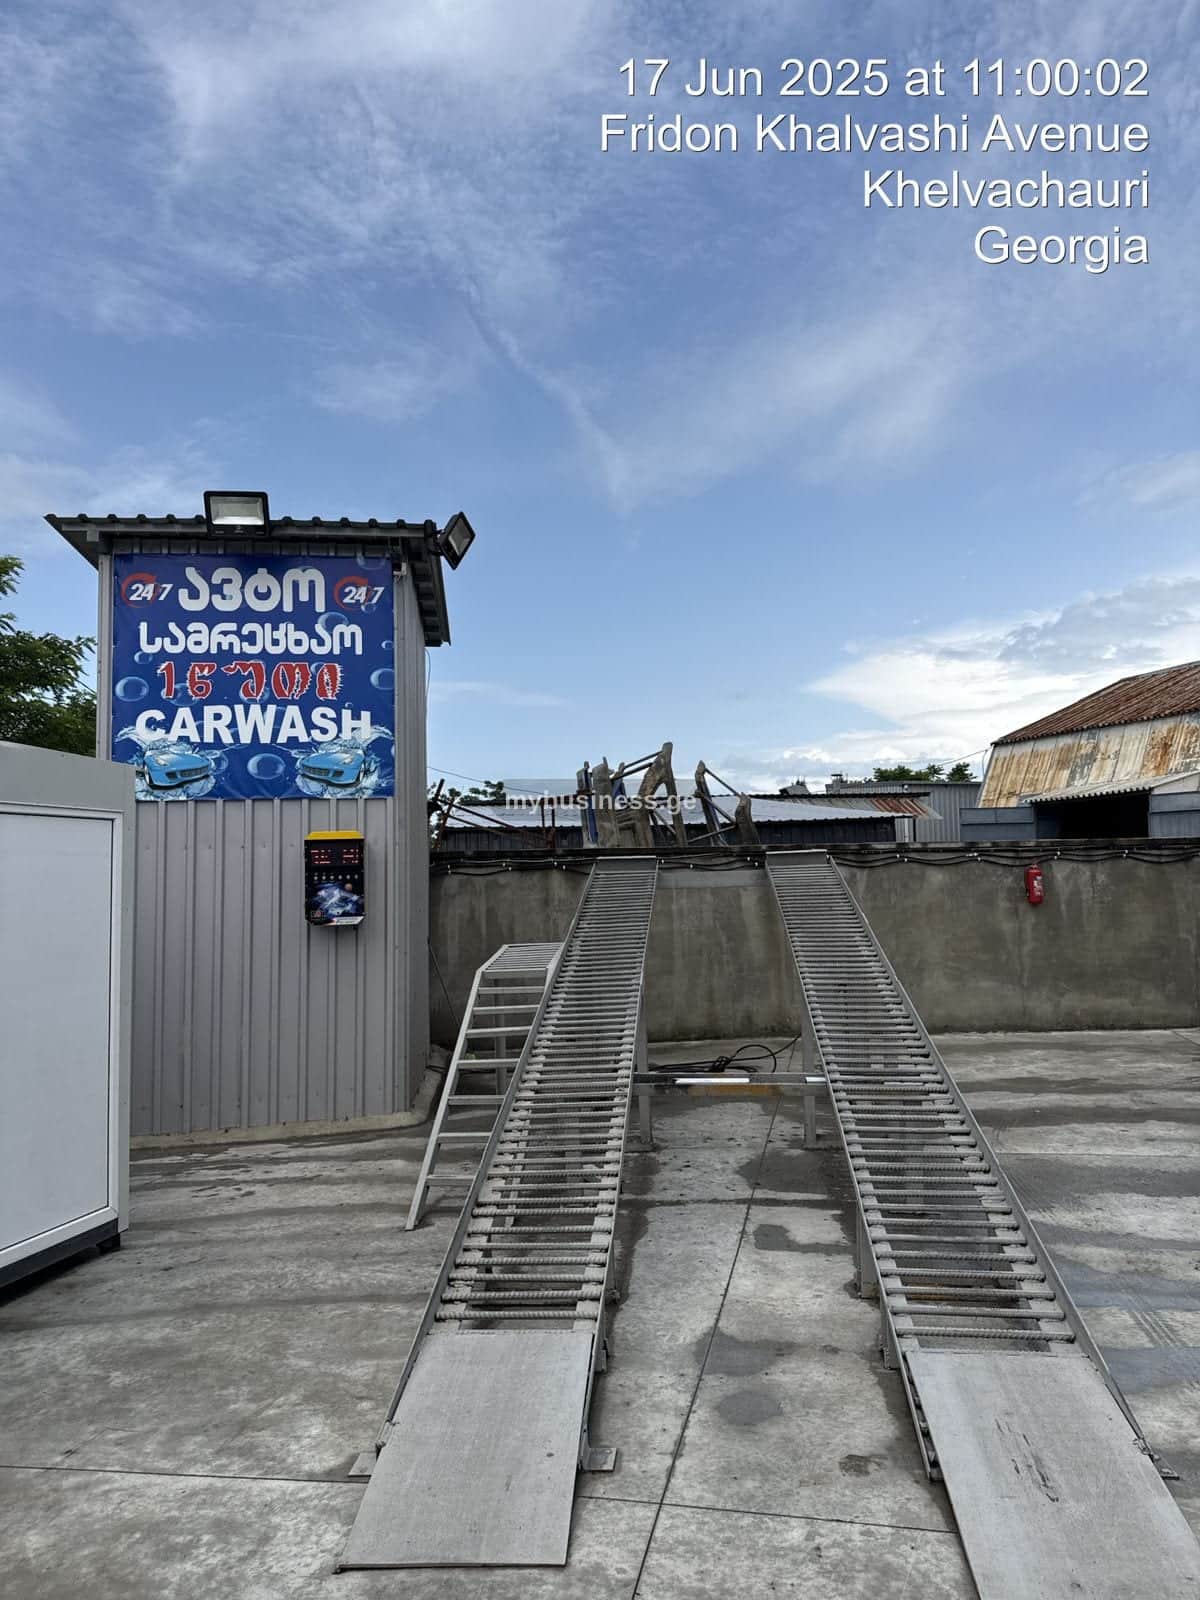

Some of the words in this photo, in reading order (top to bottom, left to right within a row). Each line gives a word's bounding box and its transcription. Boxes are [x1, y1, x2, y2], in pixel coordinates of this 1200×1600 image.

[178, 566, 326, 613] ავტო
[138, 621, 363, 655] სამრეცხაო
[135, 704, 371, 743] CARWASH
